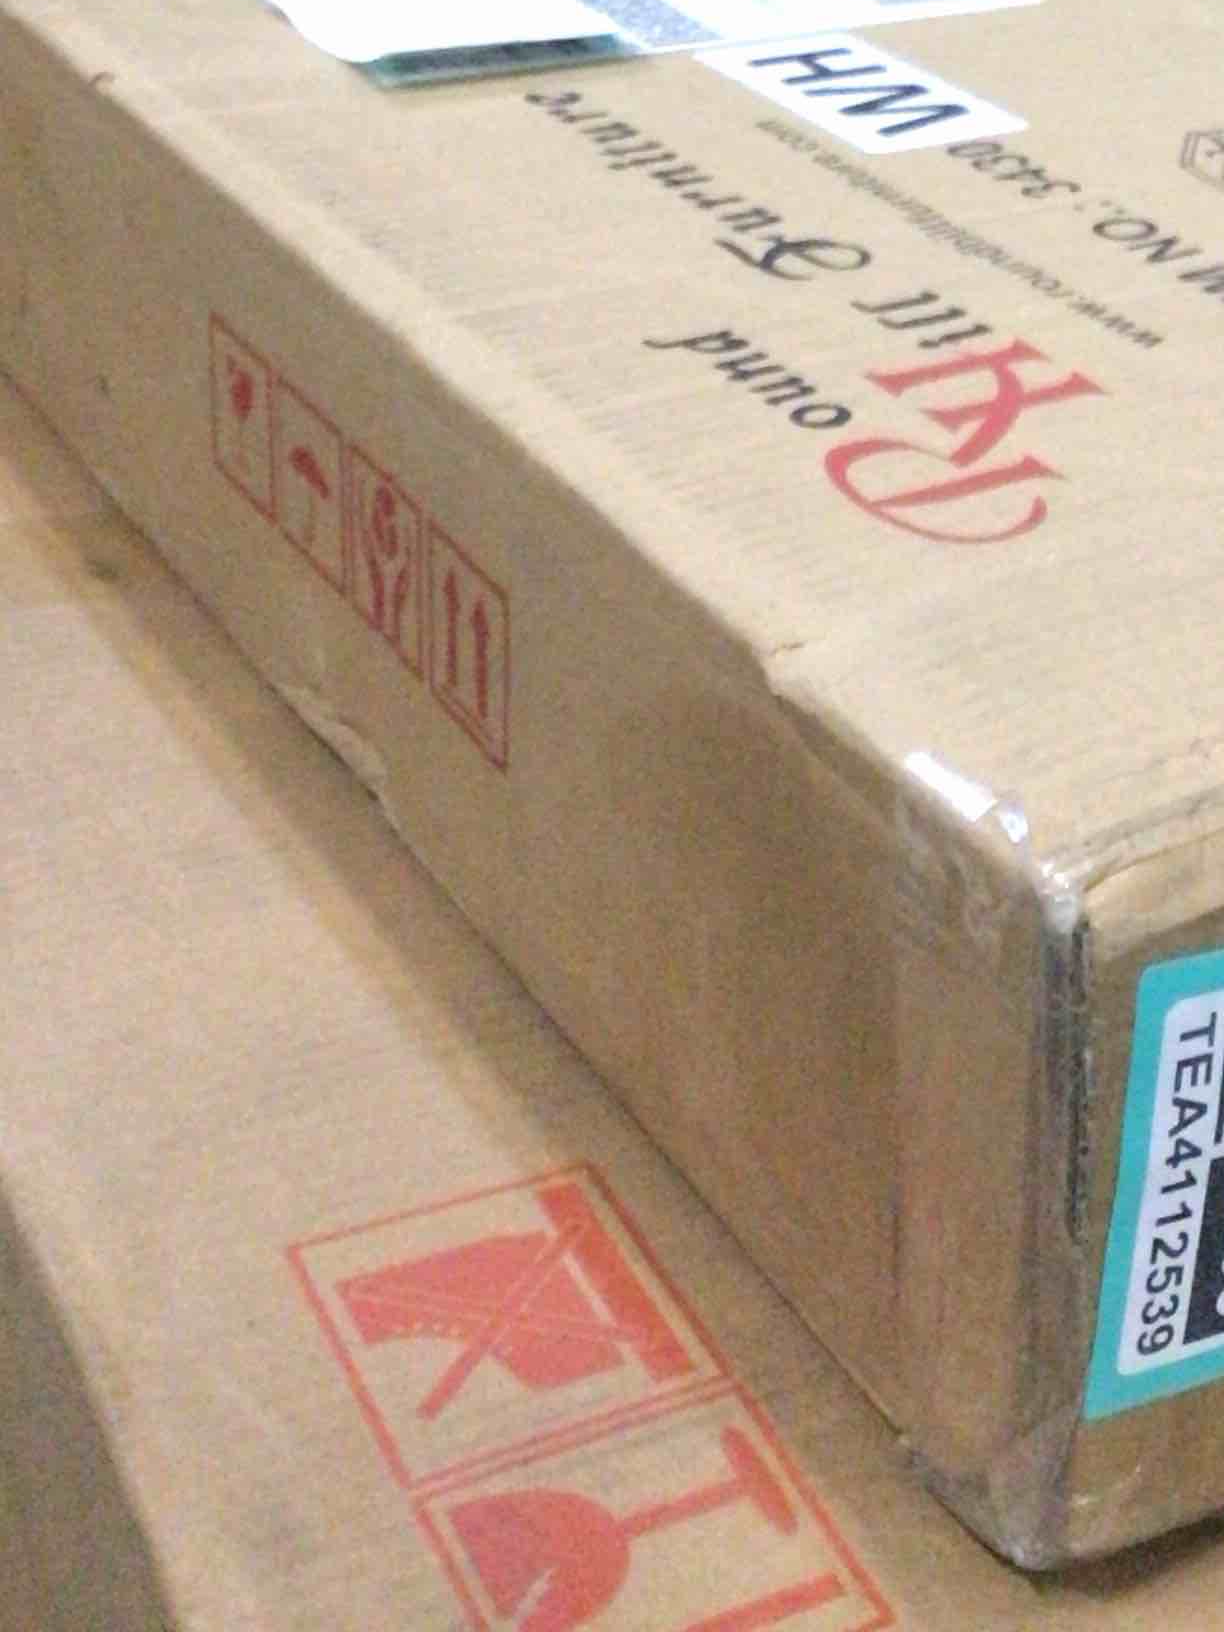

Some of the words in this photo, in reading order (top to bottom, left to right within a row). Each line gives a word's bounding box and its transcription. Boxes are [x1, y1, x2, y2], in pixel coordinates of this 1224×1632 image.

[524, 91, 873, 281] Furniture
[946, 140, 1081, 199] 3430
[1136, 1011, 1217, 1356] TEA4112539
